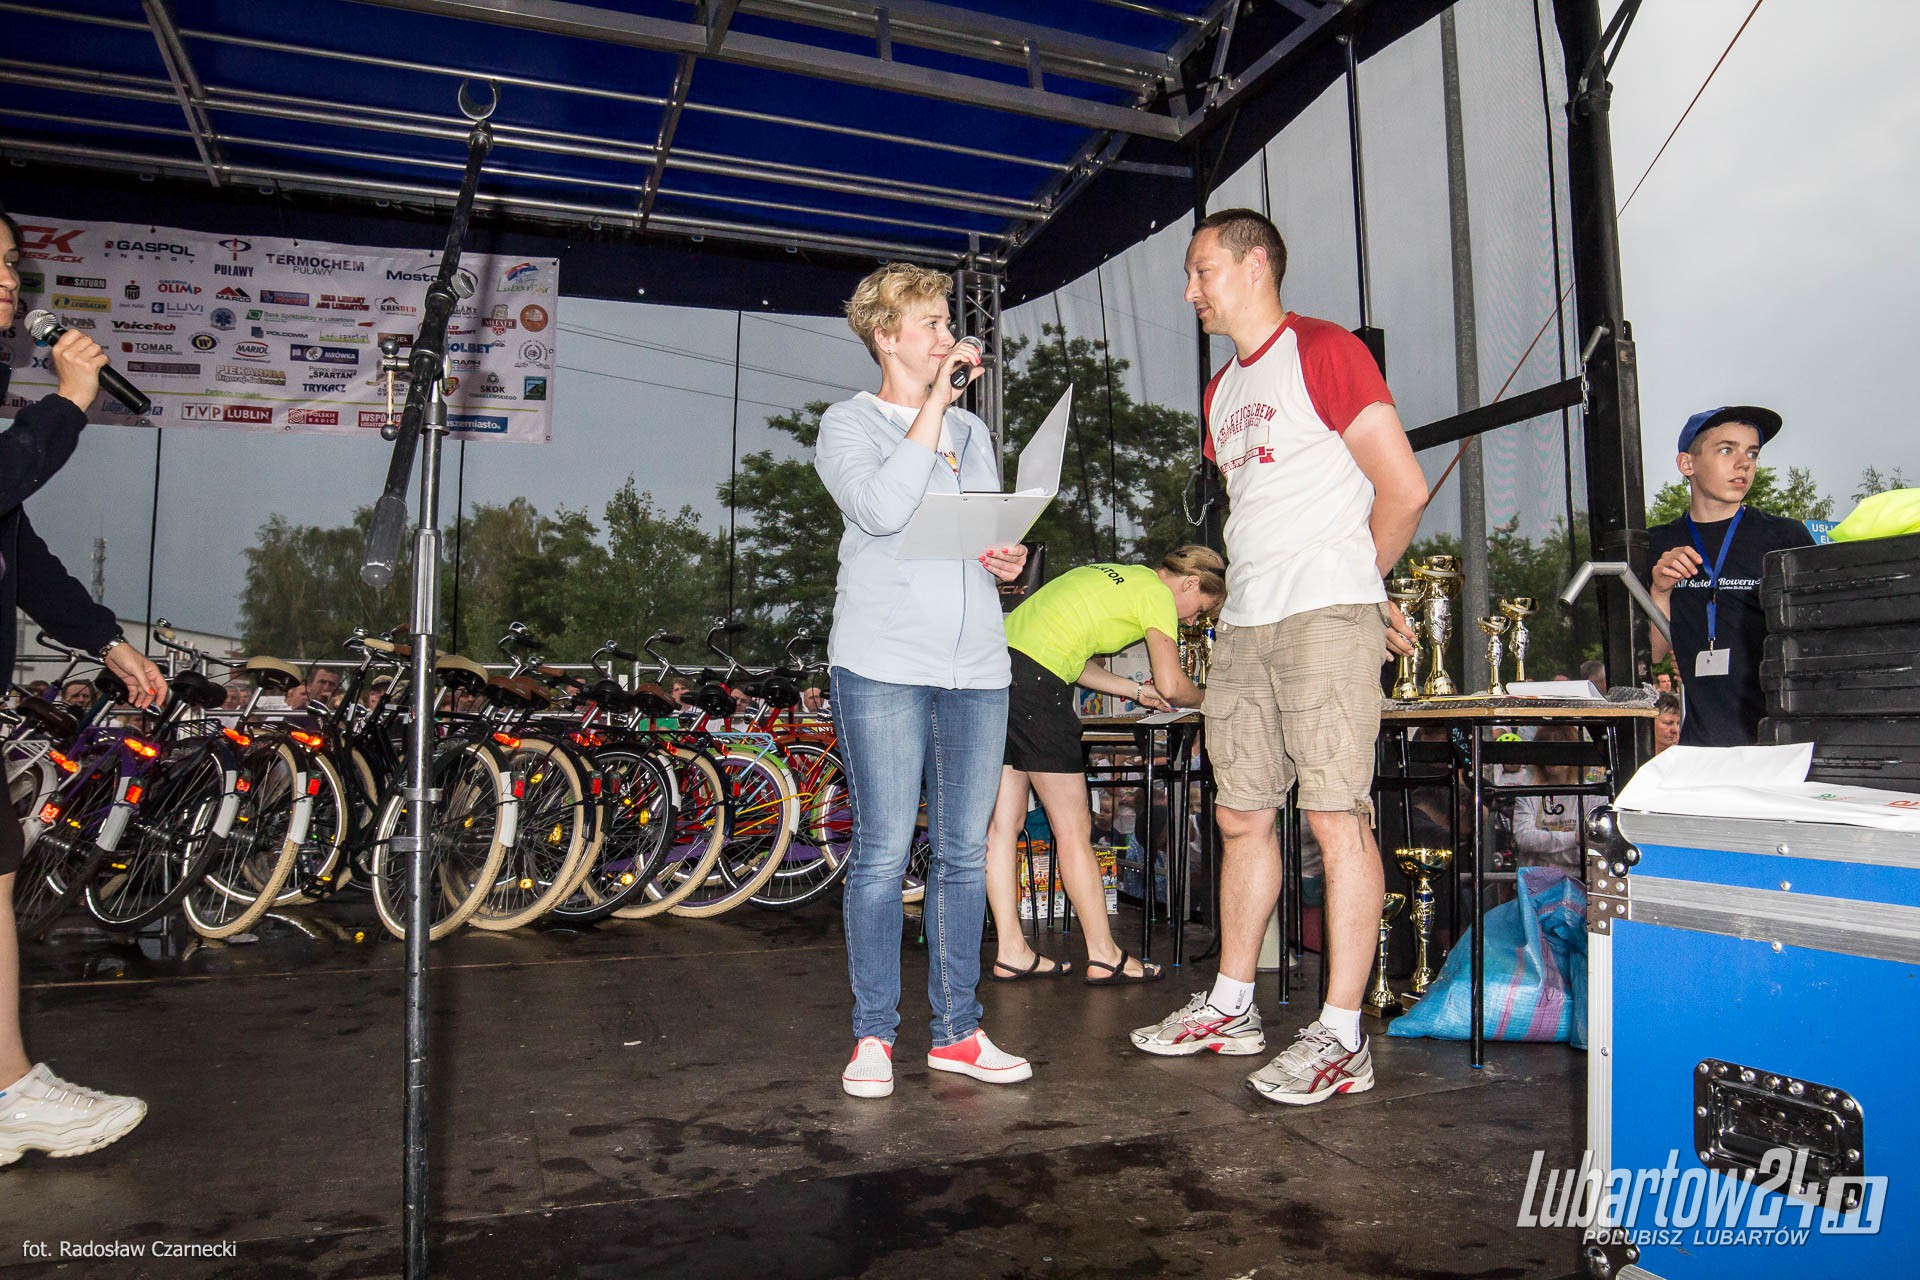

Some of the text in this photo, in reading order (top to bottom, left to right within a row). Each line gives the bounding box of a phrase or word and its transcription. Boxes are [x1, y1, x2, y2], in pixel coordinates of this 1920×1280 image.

[117, 240, 195, 256] GASPOL
[104, 252, 194, 264] ENERGY
[265, 253, 365, 272] TERMOCHEM
[214, 264, 254, 277] PUŁAWY
[293, 265, 333, 276] PUŁAWY
[386, 270, 438, 282] Mosto
[74, 279, 105, 288] SATURN
[158, 283, 202, 295] OLIMP
[166, 303, 203, 313] LUVI
[111, 320, 176, 332] VoiceTech
[265, 330, 309, 339] POLCOMM
[135, 342, 173, 352] TOMAR
[236, 344, 268, 355] MARIOL
[448, 343, 493, 354] OLBET
[216, 365, 286, 379] PIEKARNIA
[302, 383, 347, 393] TRYKACZ
[480, 384, 506, 394] SKOK
[184, 405, 269, 420] TVP LUBLIN
